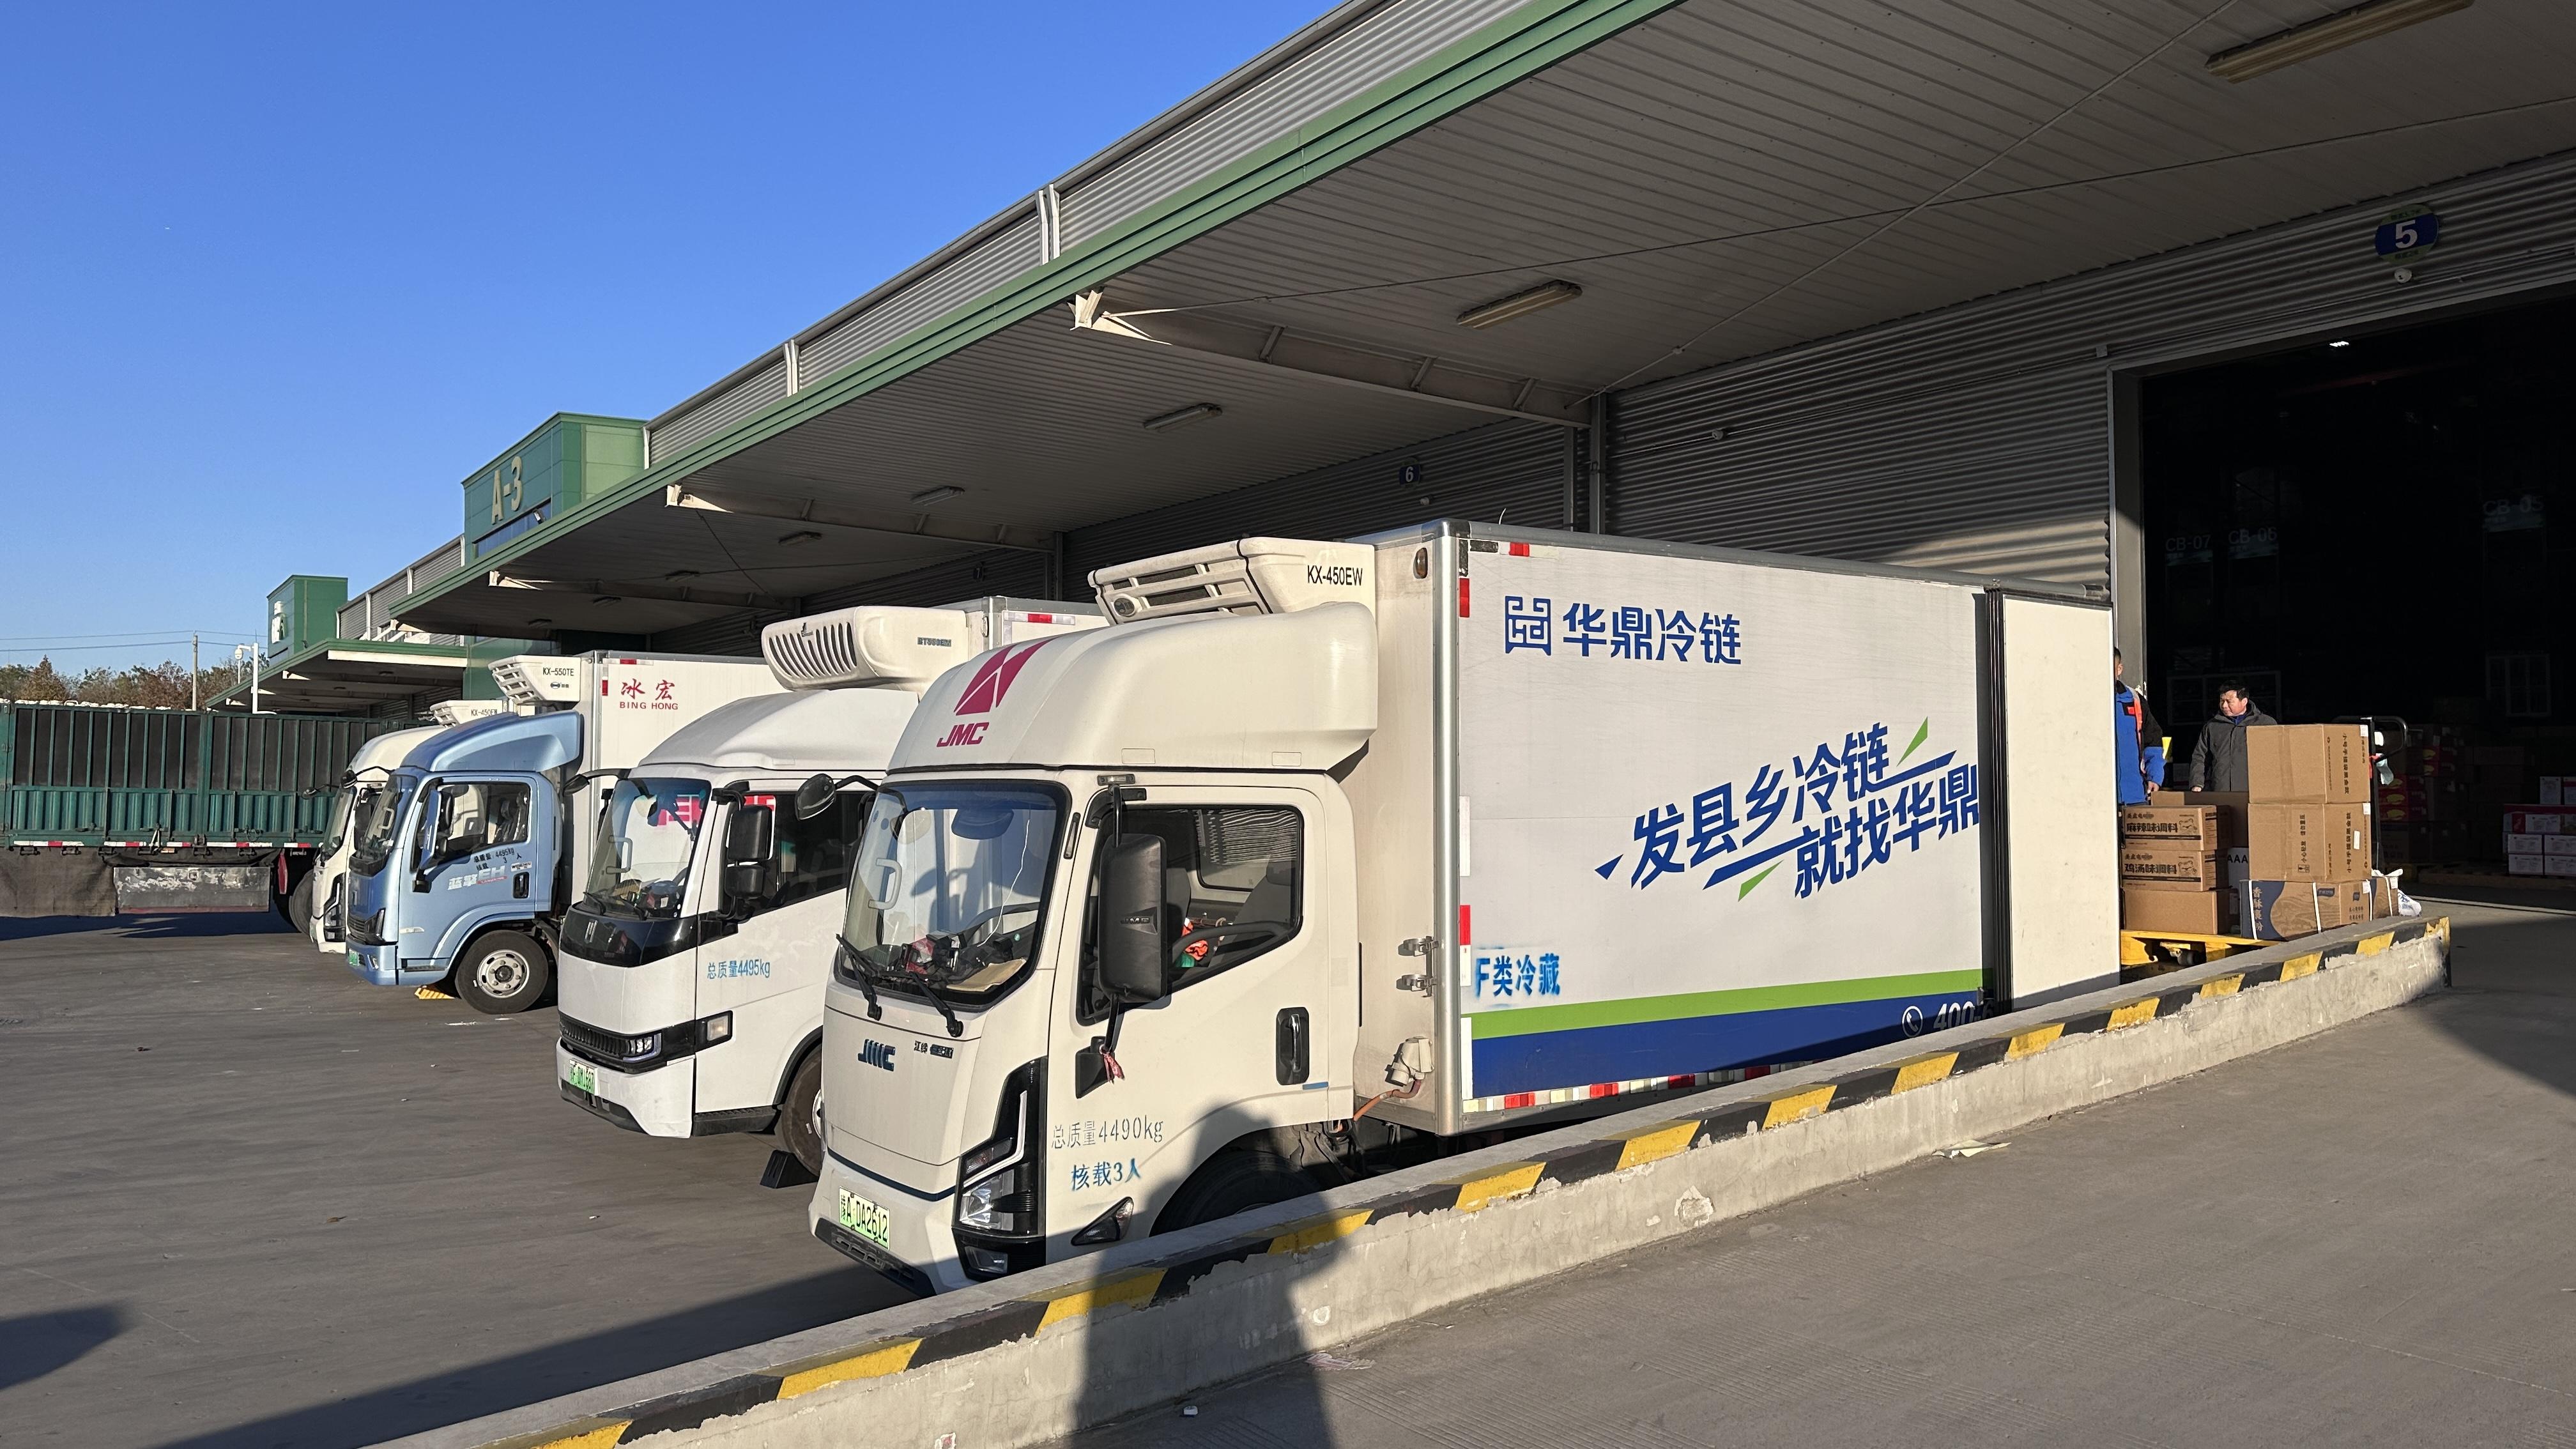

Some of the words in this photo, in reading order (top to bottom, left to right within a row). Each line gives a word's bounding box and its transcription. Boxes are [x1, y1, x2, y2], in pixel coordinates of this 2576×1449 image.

[2395, 219, 2418, 249] 5
[1405, 466, 1414, 483] 6
[491, 456, 523, 525] A-3
[2165, 534, 2212, 552] CB-07
[1307, 565, 1363, 586] KX-450EW
[1563, 602, 1741, 664] 华鼎冷链
[542, 667, 574, 677] KX-550TE
[621, 678, 676, 702] 冰宏
[619, 702, 648, 710] BING
[651, 702, 678, 710] HONG
[937, 722, 989, 747] JMC
[1631, 721, 1890, 889] 发县乡冷链
[1795, 763, 1979, 900] 就找华鼎
[2126, 822, 2178, 832] 麻辣味调料
[2124, 863, 2177, 875] 鸡汤味调料
[1476, 953, 1560, 998] F类冷藏
[857, 1039, 896, 1071] JMC
[1071, 1158, 1142, 1192] 核载3人
